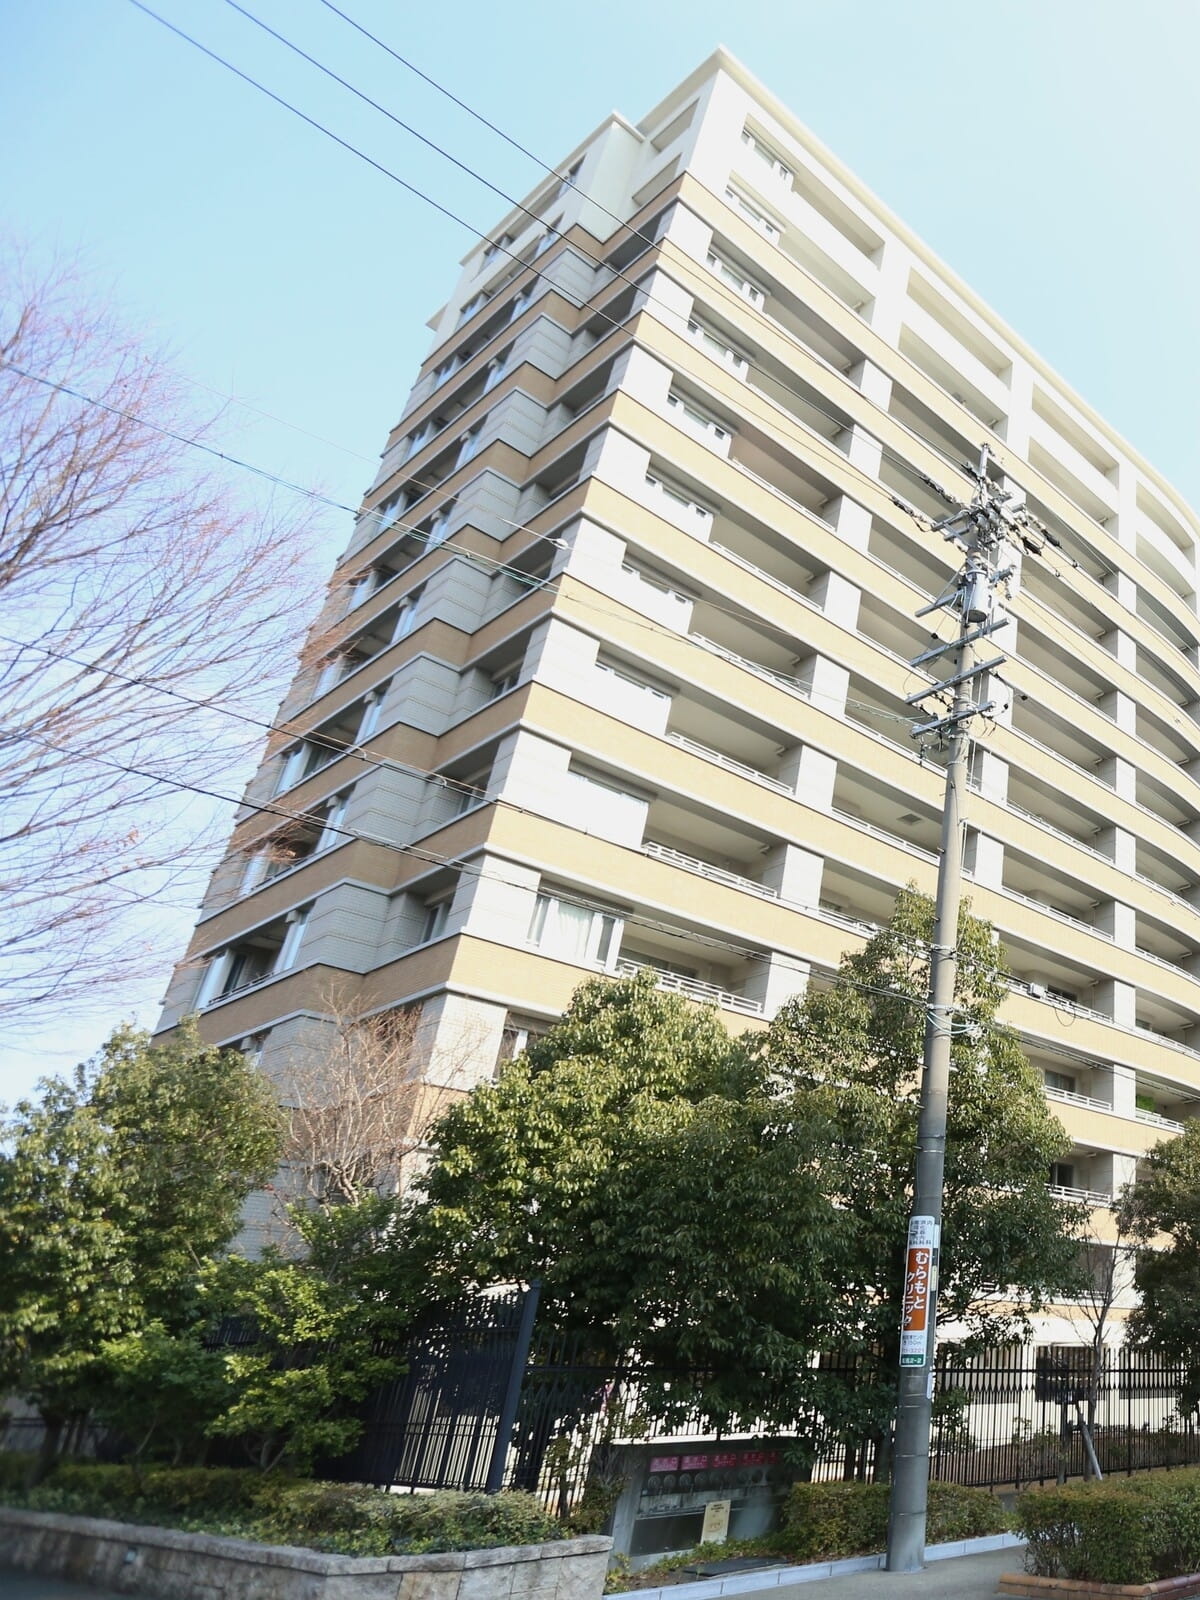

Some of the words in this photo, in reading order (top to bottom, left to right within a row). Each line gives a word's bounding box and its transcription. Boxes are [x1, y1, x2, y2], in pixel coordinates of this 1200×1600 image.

[904, 1272, 916, 1327] クリニック
[914, 1251, 929, 1310] むらもと
